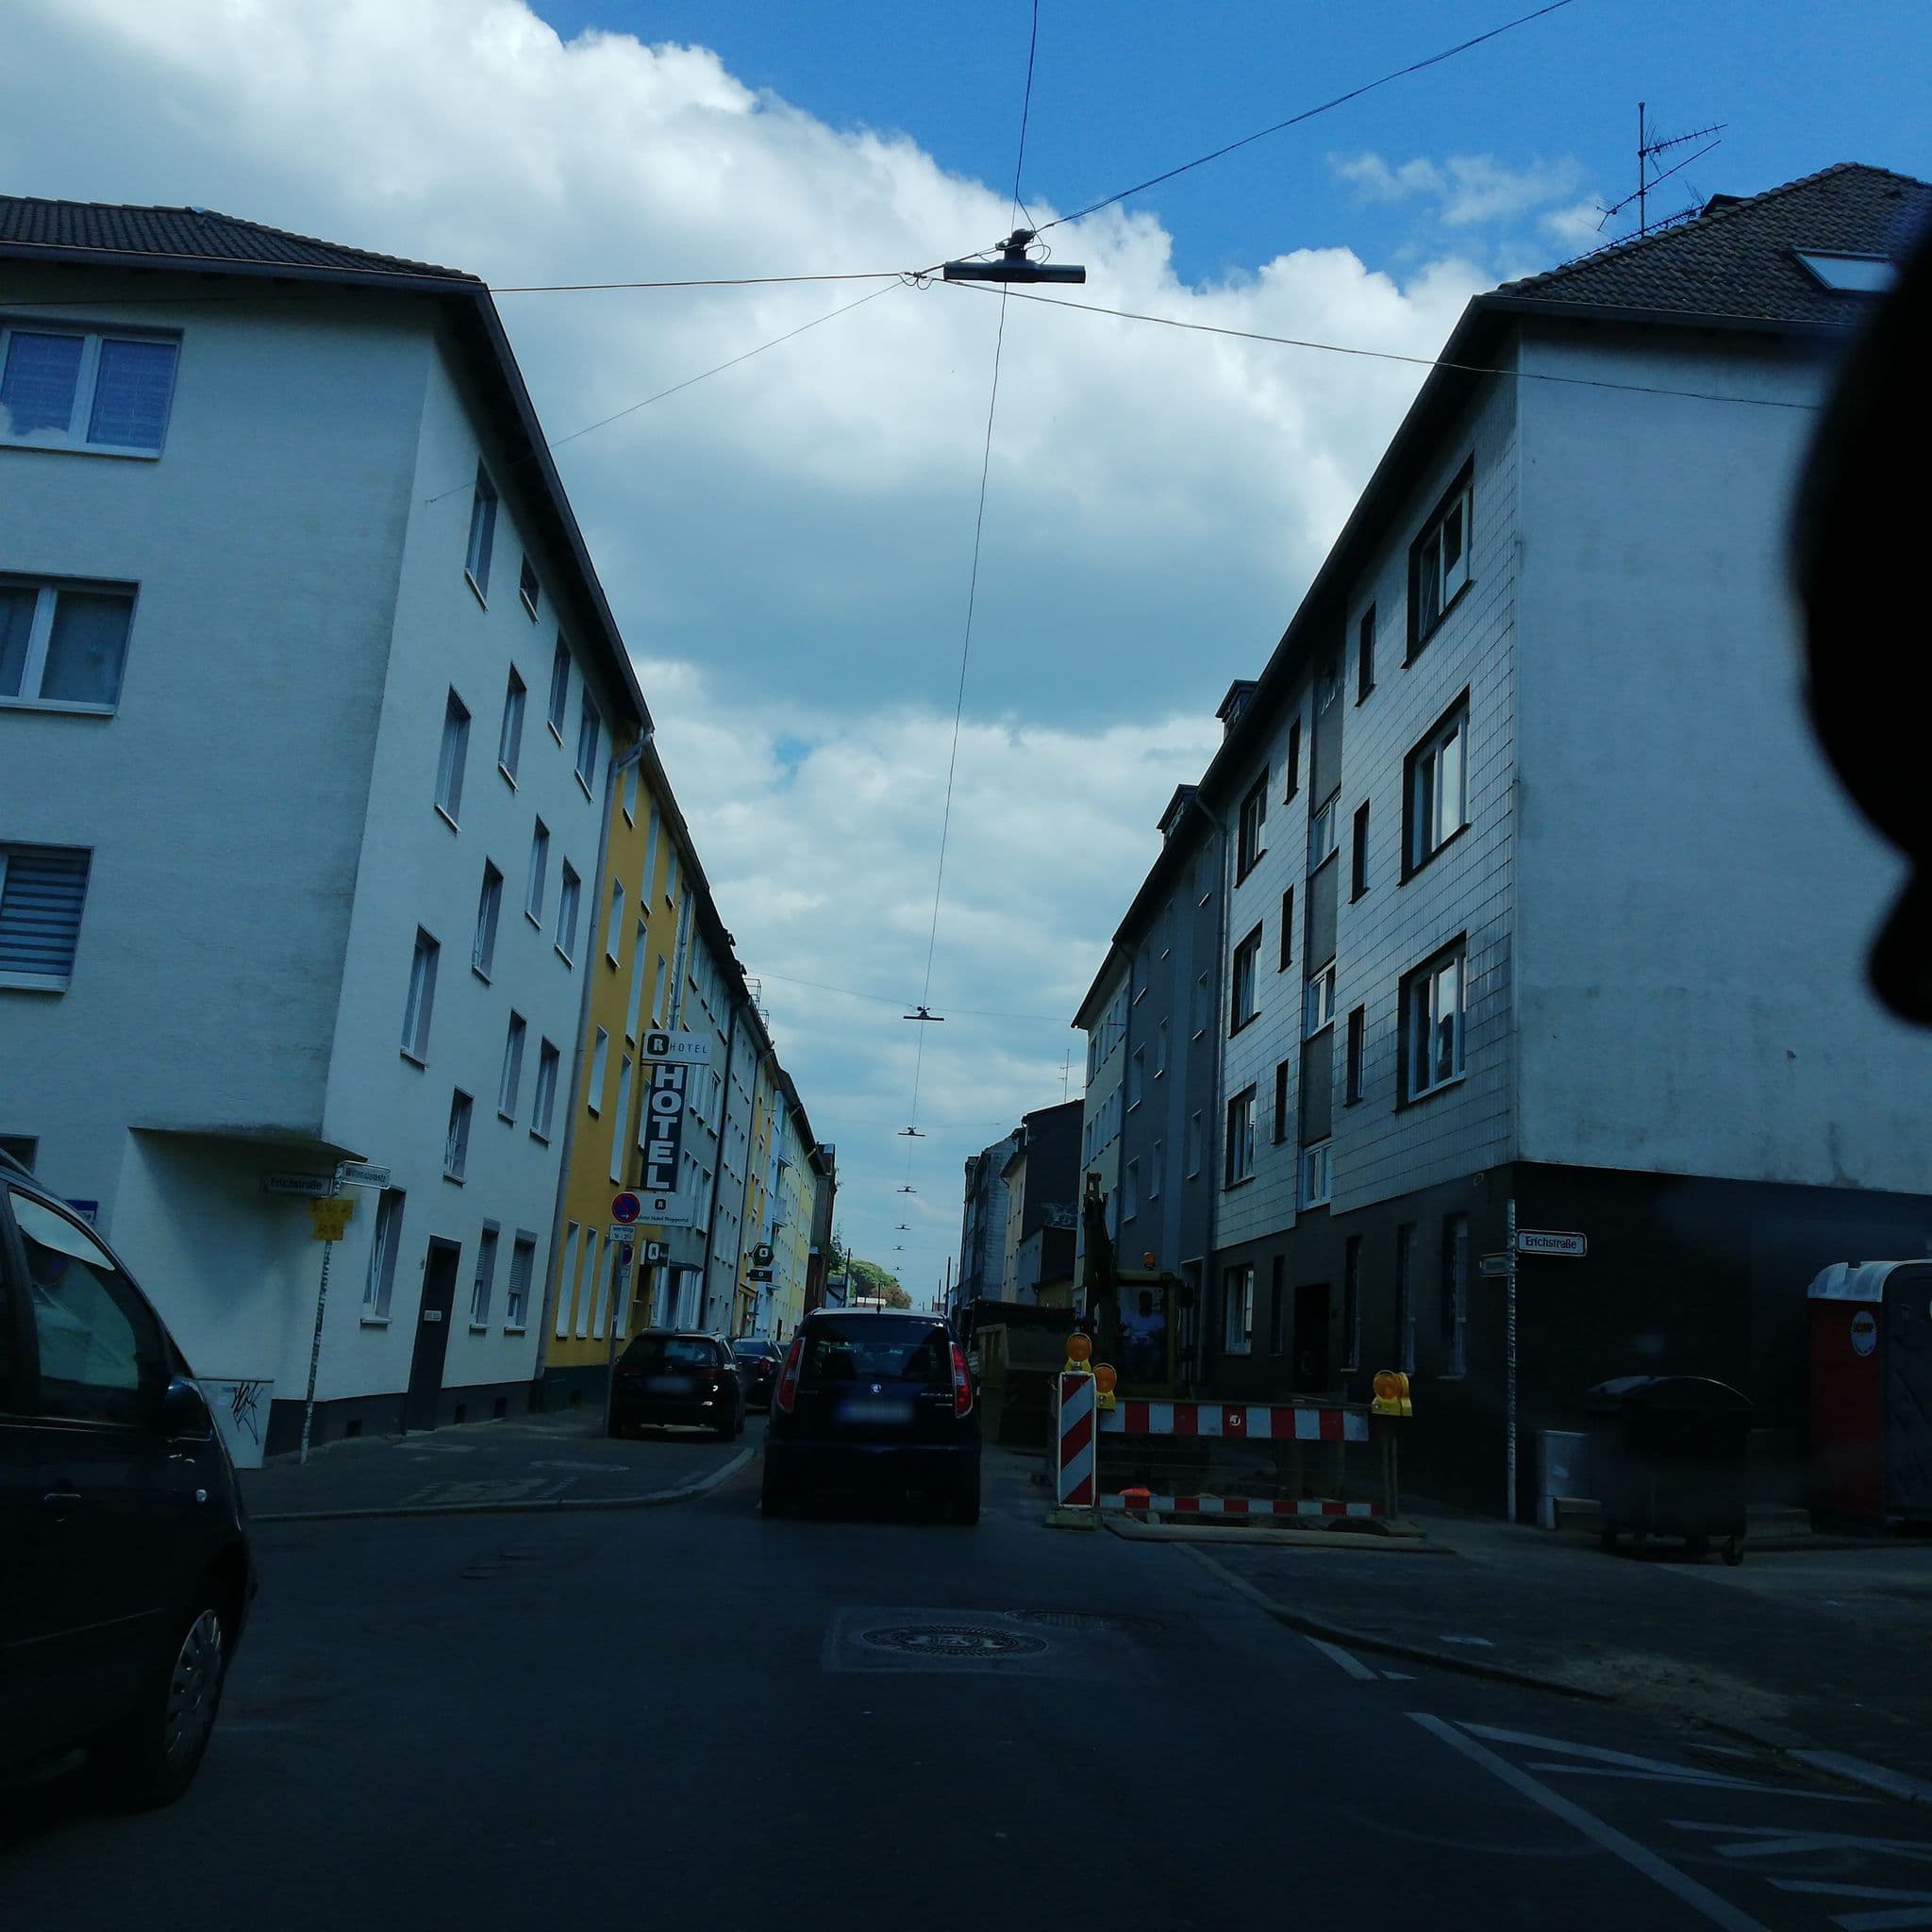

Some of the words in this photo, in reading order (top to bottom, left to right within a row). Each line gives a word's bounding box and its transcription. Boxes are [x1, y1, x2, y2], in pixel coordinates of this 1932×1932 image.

[670, 1042, 708, 1054] HOTEL
[646, 1064, 685, 1189] HOTEL
[1525, 1236, 1577, 1249] Erichstraße
